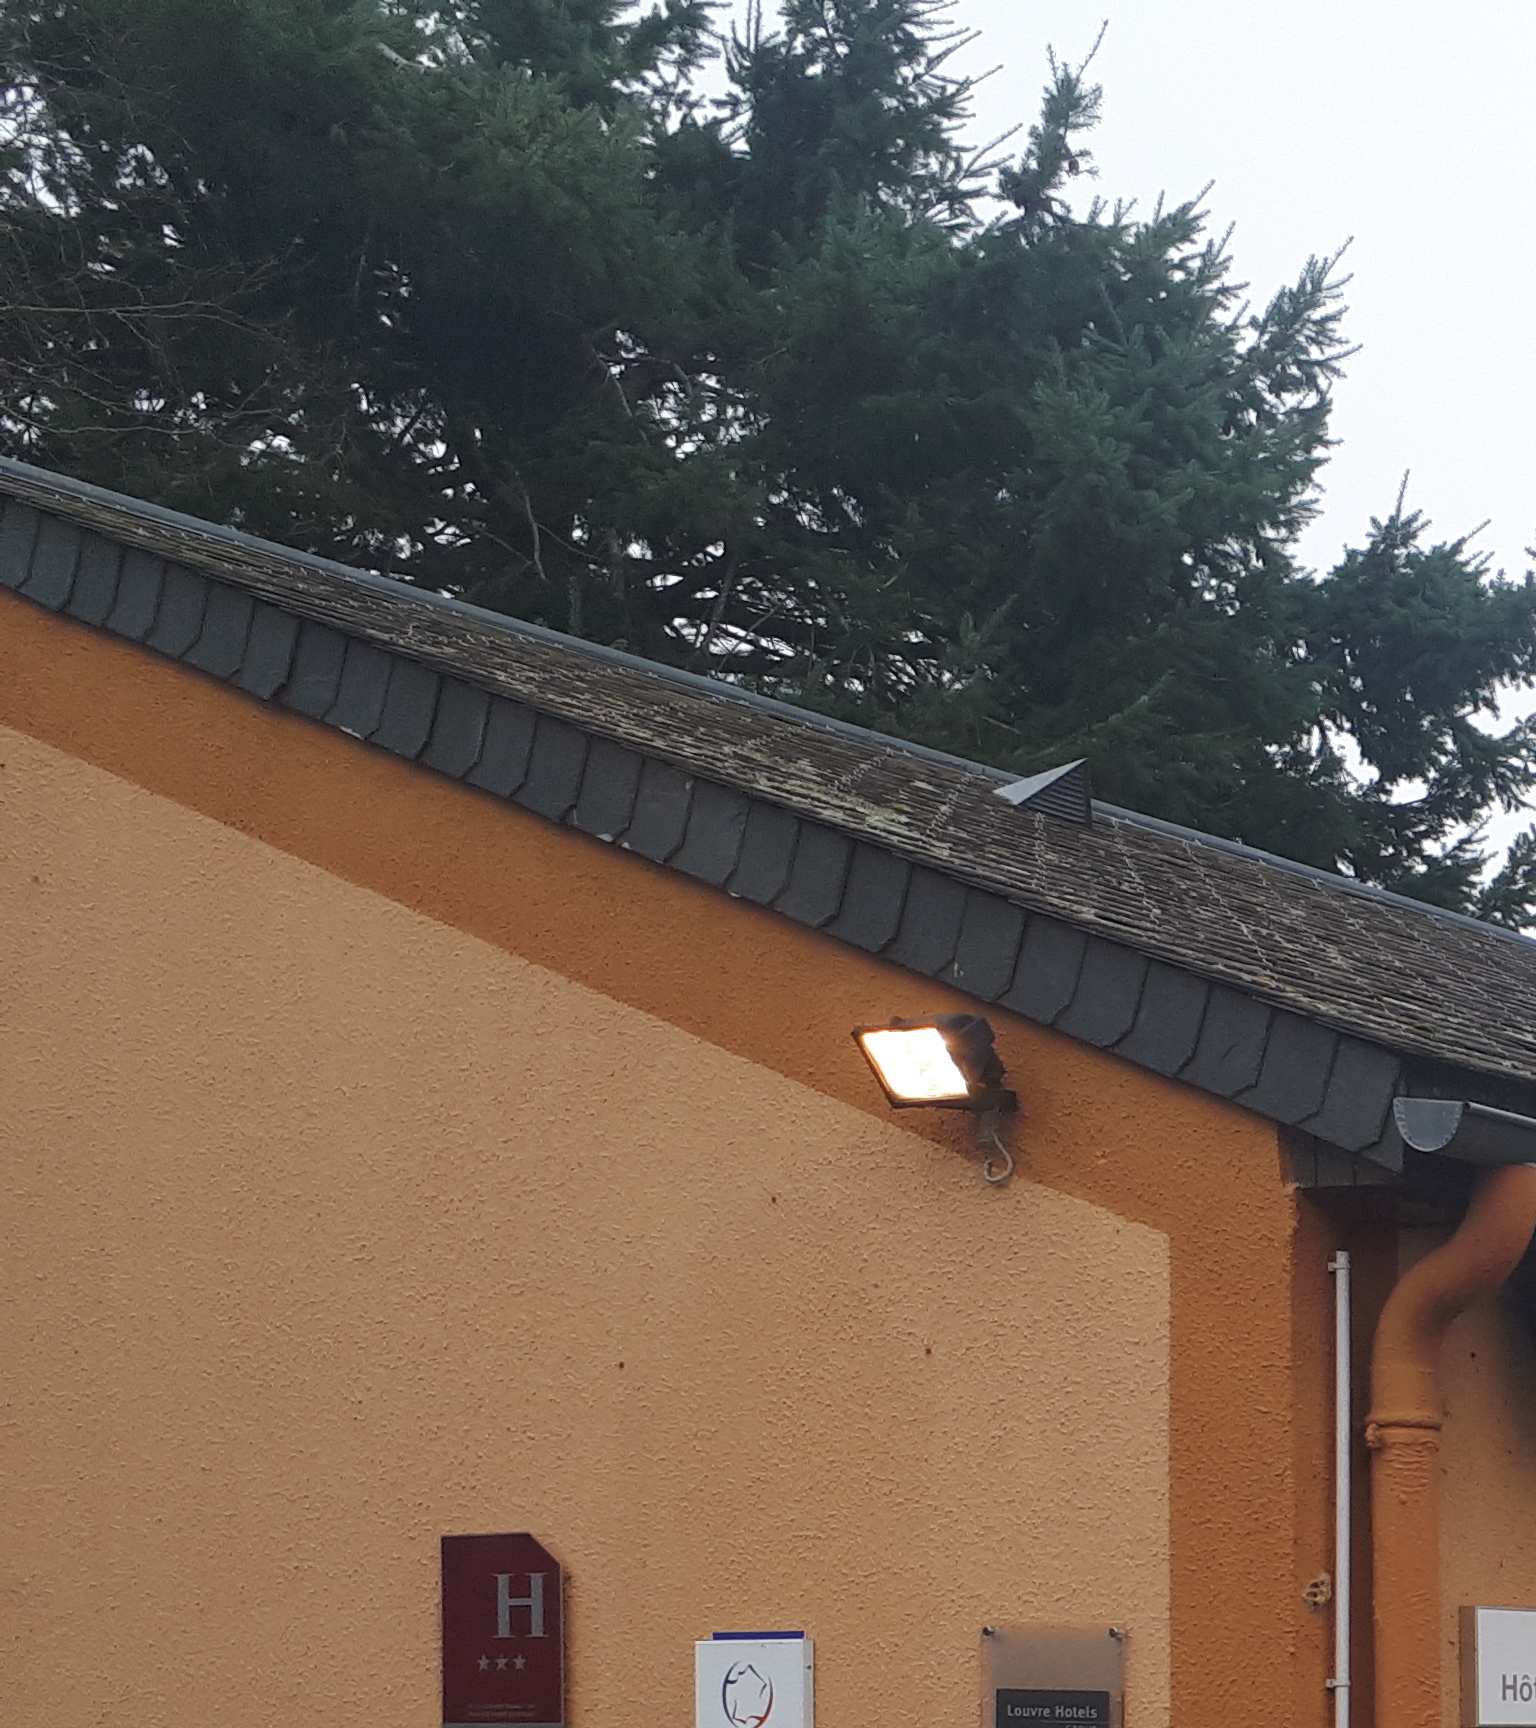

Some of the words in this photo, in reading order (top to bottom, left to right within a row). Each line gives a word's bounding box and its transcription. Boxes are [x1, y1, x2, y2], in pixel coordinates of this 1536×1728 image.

[492, 1572, 549, 1638] H
[1007, 1704, 1051, 1718] Louvre
[1055, 1705, 1098, 1719] Hotels
